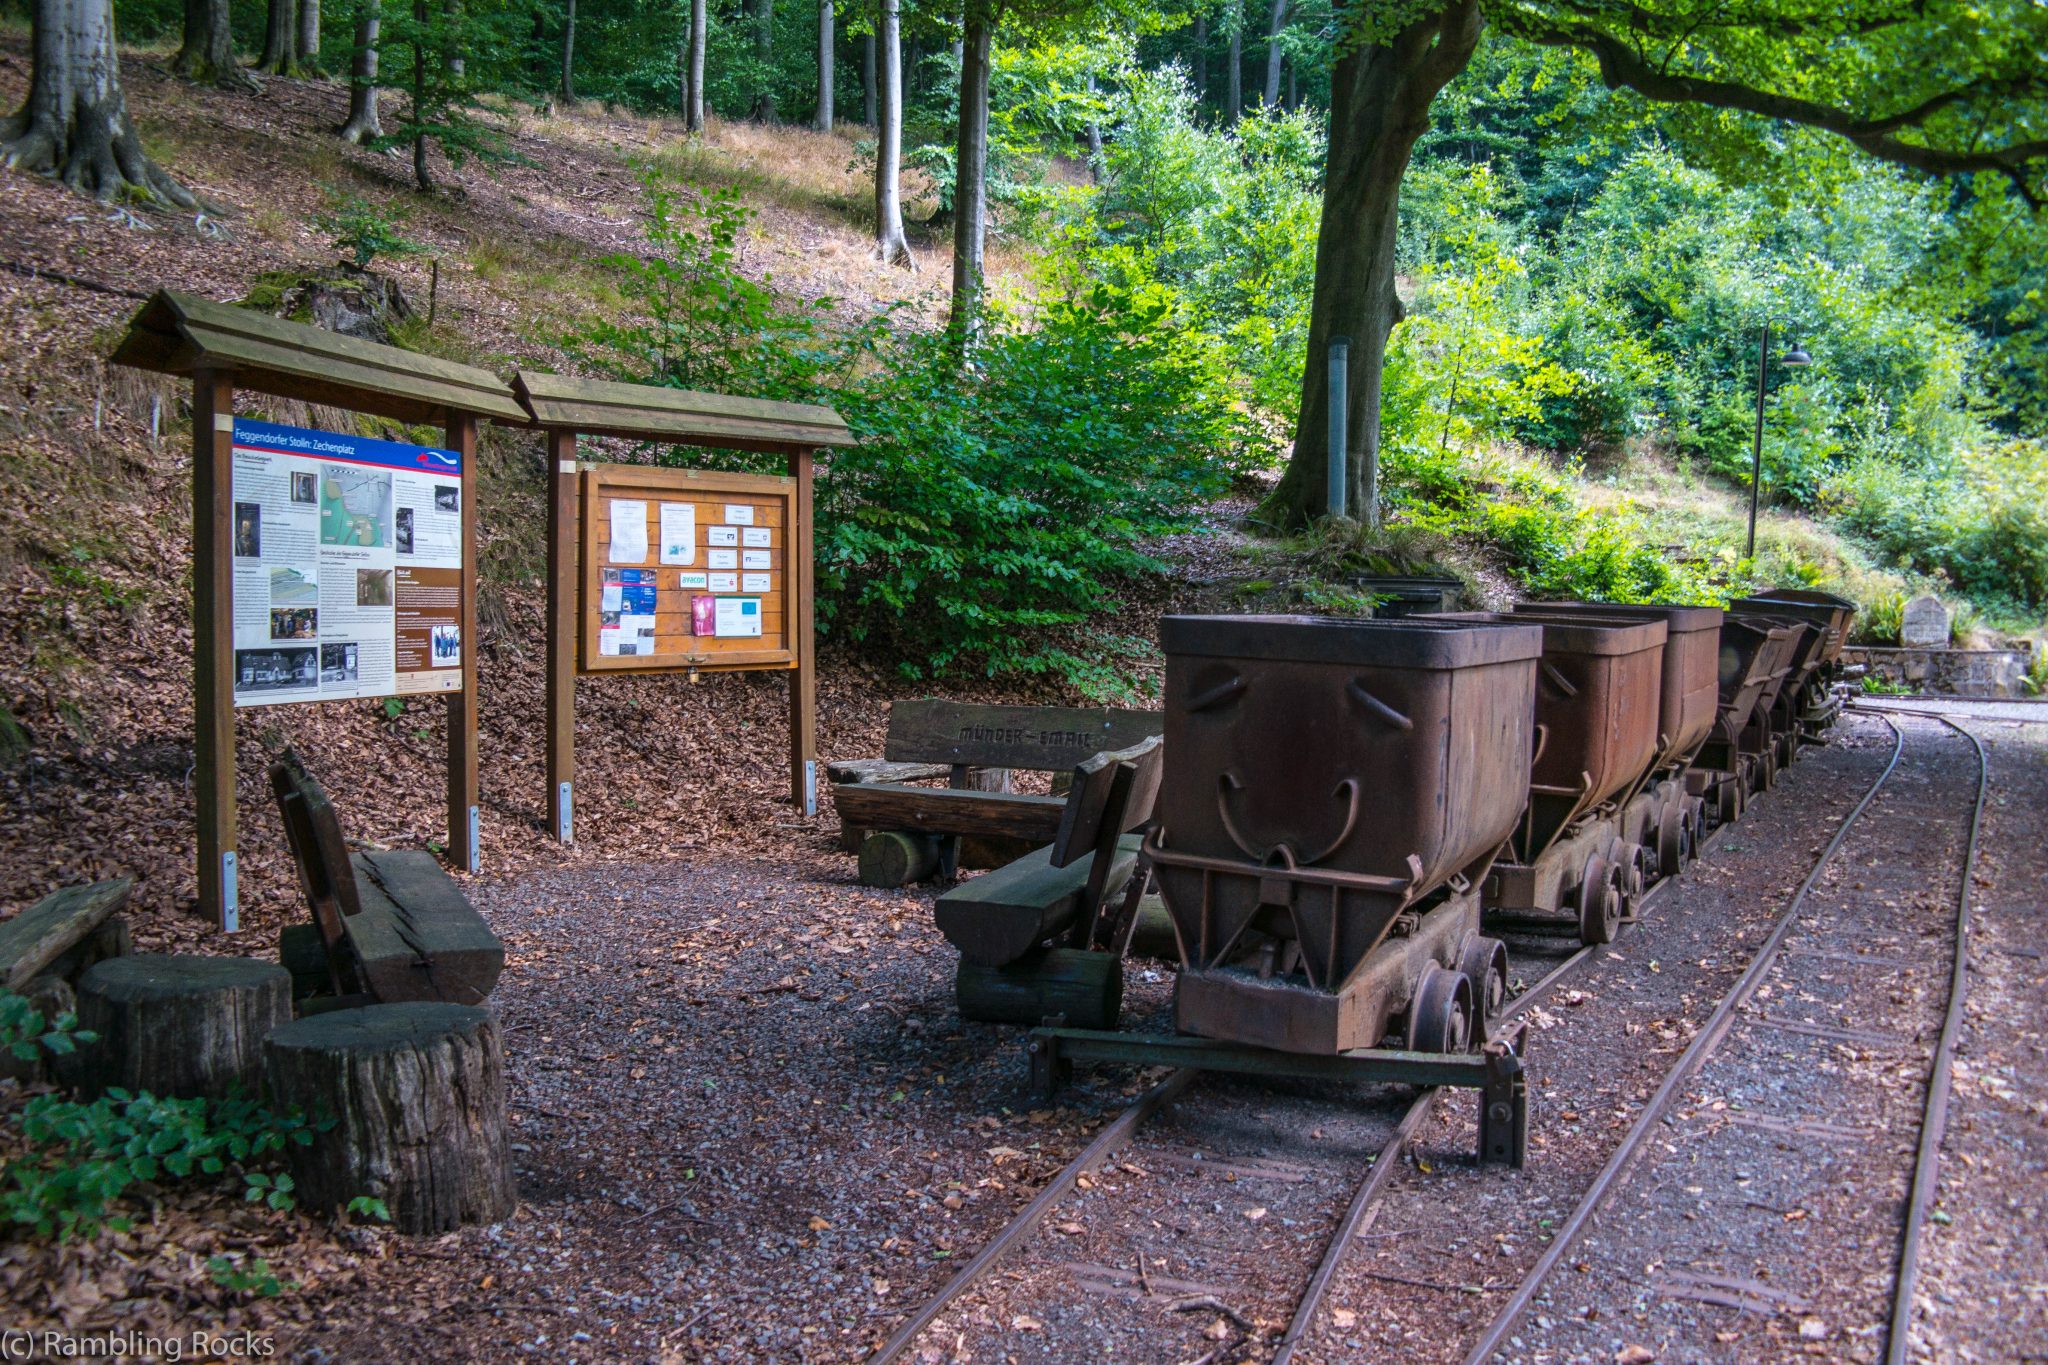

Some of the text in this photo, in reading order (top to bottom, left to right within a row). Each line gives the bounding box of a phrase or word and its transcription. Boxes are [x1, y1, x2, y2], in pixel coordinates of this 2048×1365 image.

[235, 428, 355, 455] Feggendorfer Stolln: Zechenplatz
[682, 576, 704, 584] avacon
